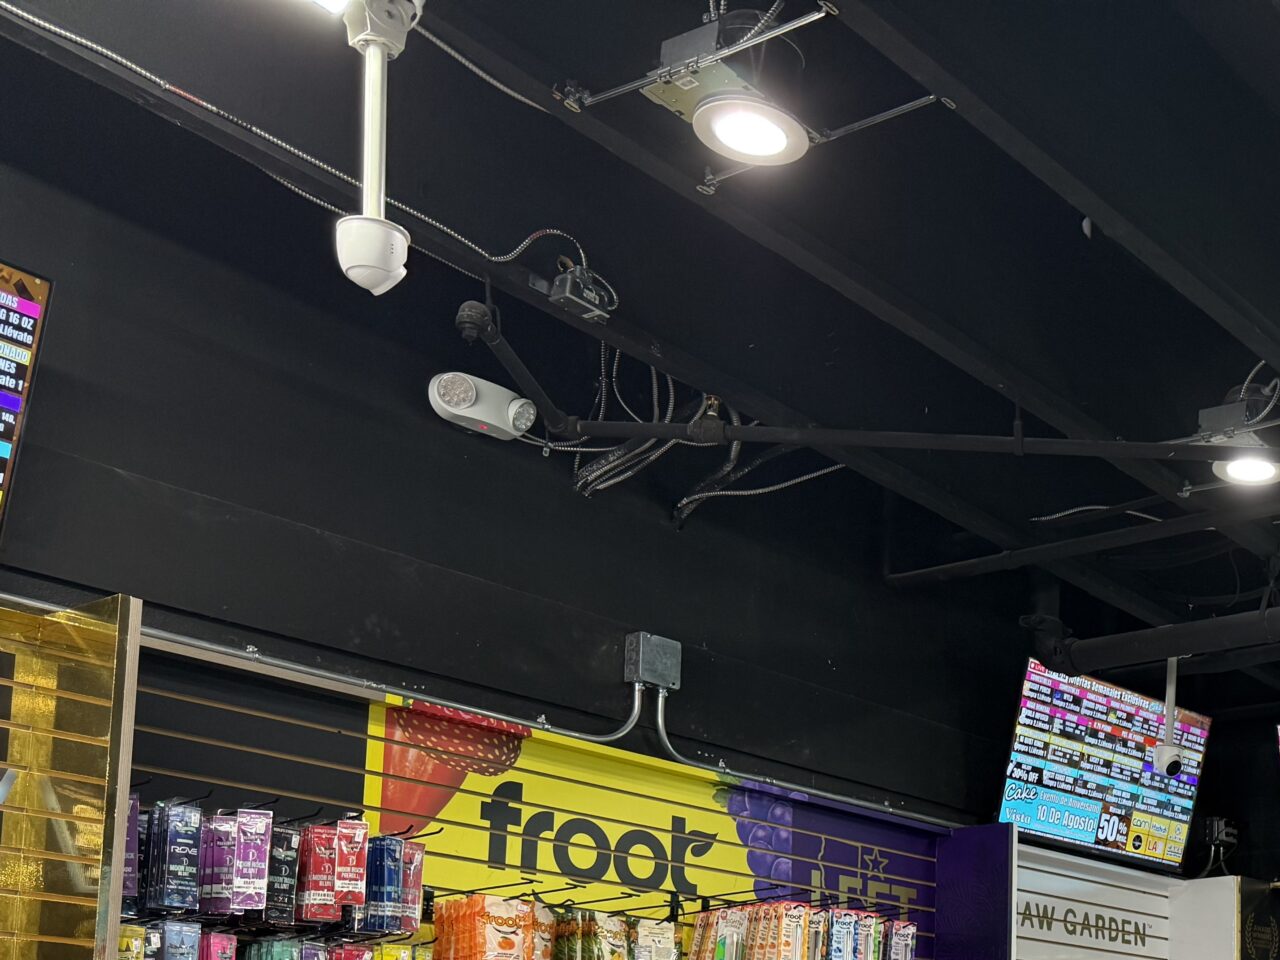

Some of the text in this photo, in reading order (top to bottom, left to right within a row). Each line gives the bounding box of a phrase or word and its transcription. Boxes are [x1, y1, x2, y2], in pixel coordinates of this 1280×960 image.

[9, 311, 34, 330] 16 OZ
[1029, 771, 1039, 784] OFF
[1004, 784, 1039, 801] Cake
[1005, 806, 1031, 825] Vista
[1036, 804, 1097, 833] 10 De Agosto!
[481, 781, 719, 899] froot
[1017, 901, 1147, 947] AW GARDEN
